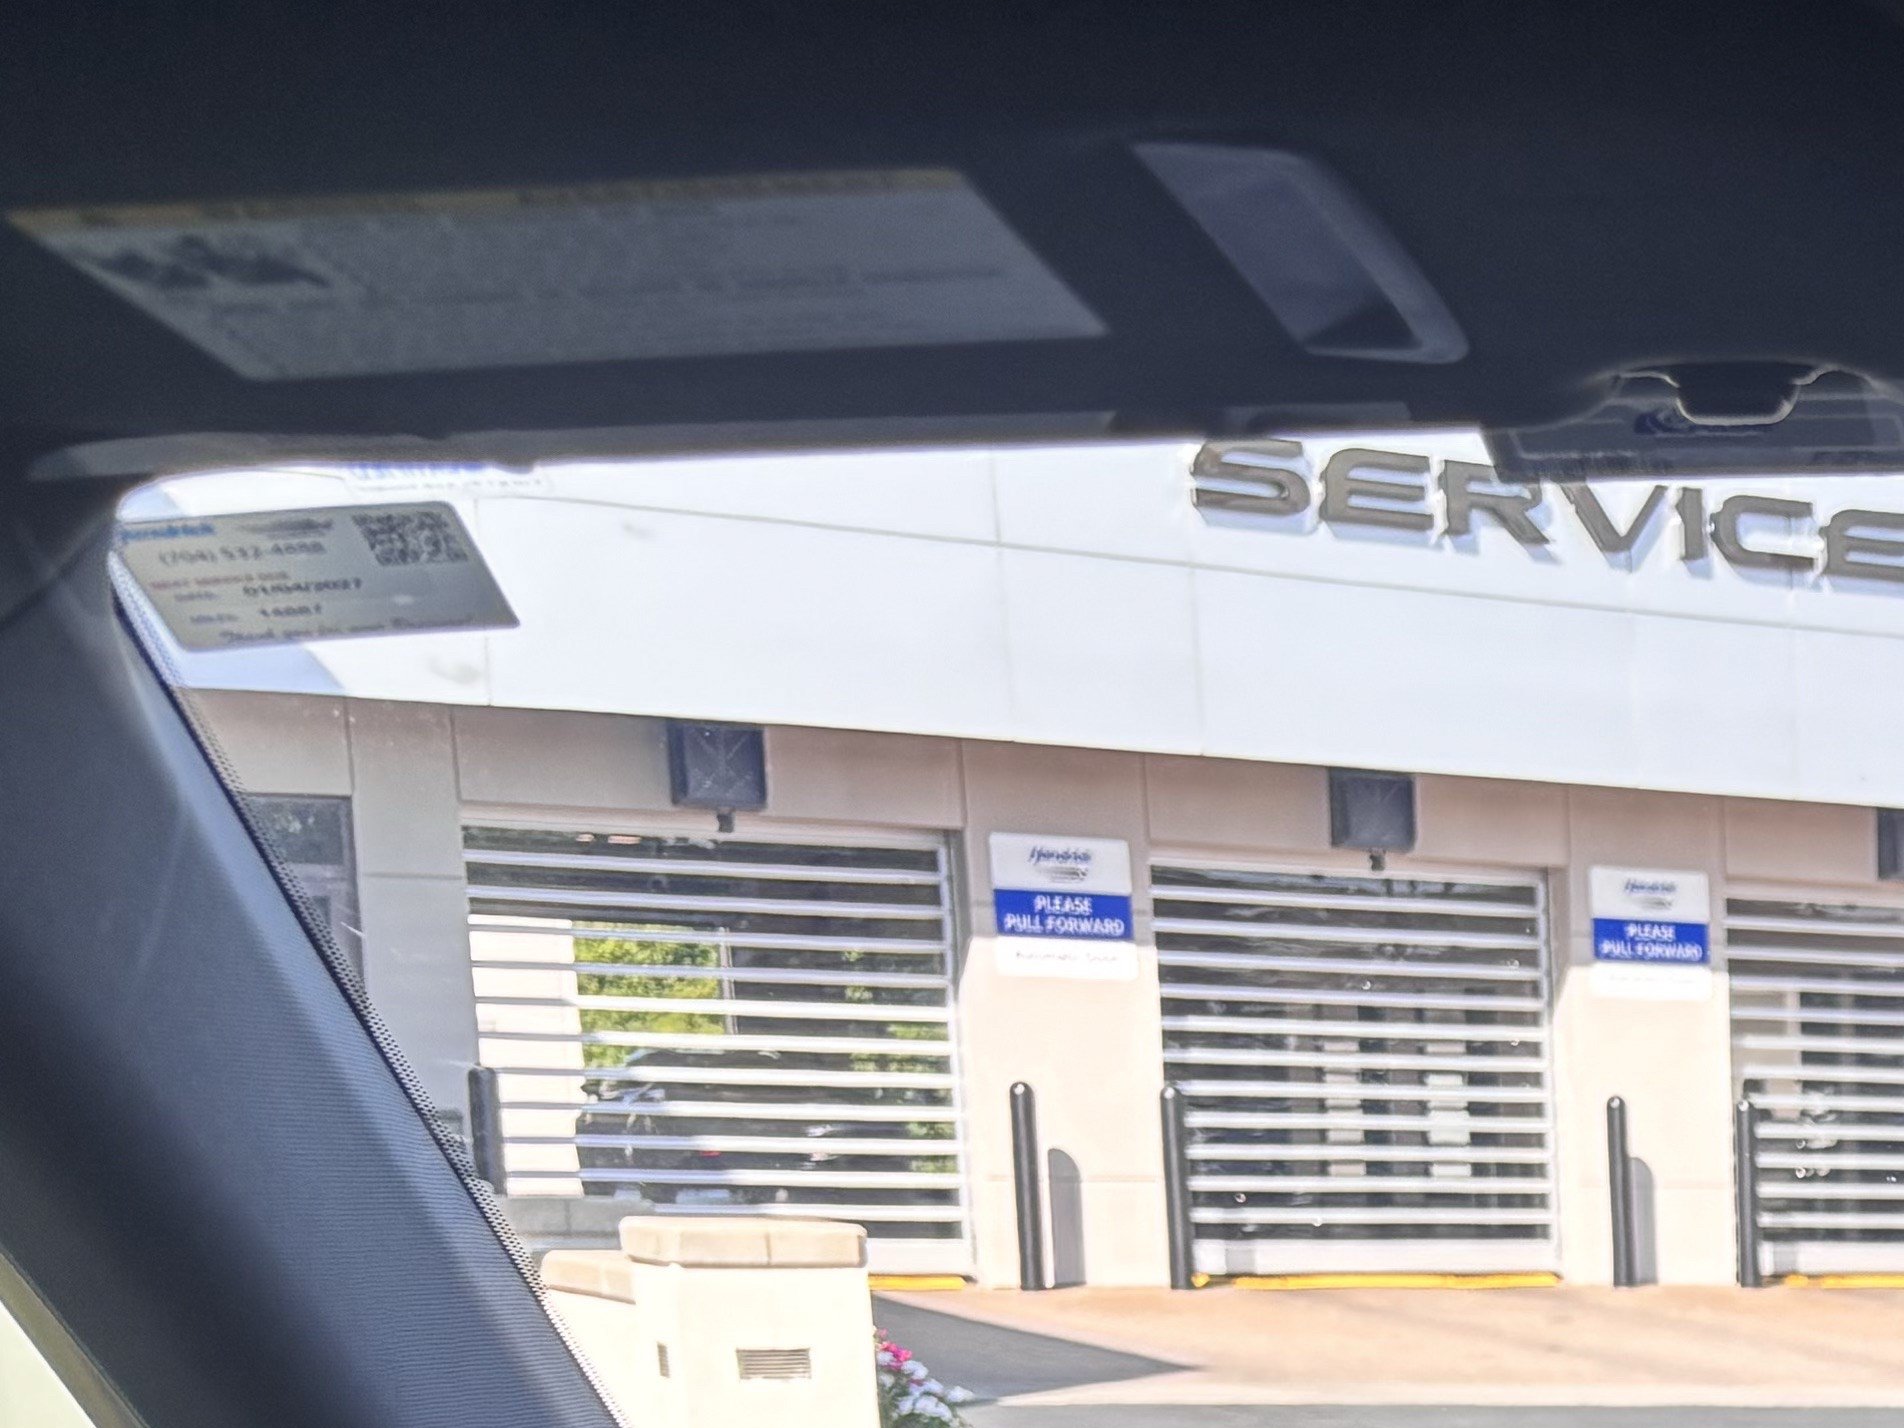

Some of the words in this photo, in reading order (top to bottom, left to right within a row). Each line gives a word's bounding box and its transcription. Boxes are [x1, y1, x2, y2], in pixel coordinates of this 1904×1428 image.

[1033, 894, 1093, 916] PLEASE
[1004, 912, 1043, 934] PULL
[1045, 915, 1126, 938] FORWARD
[1625, 923, 1677, 942] PLEASE
[1600, 940, 1633, 958] PULL
[1634, 941, 1703, 961] FORWARD
